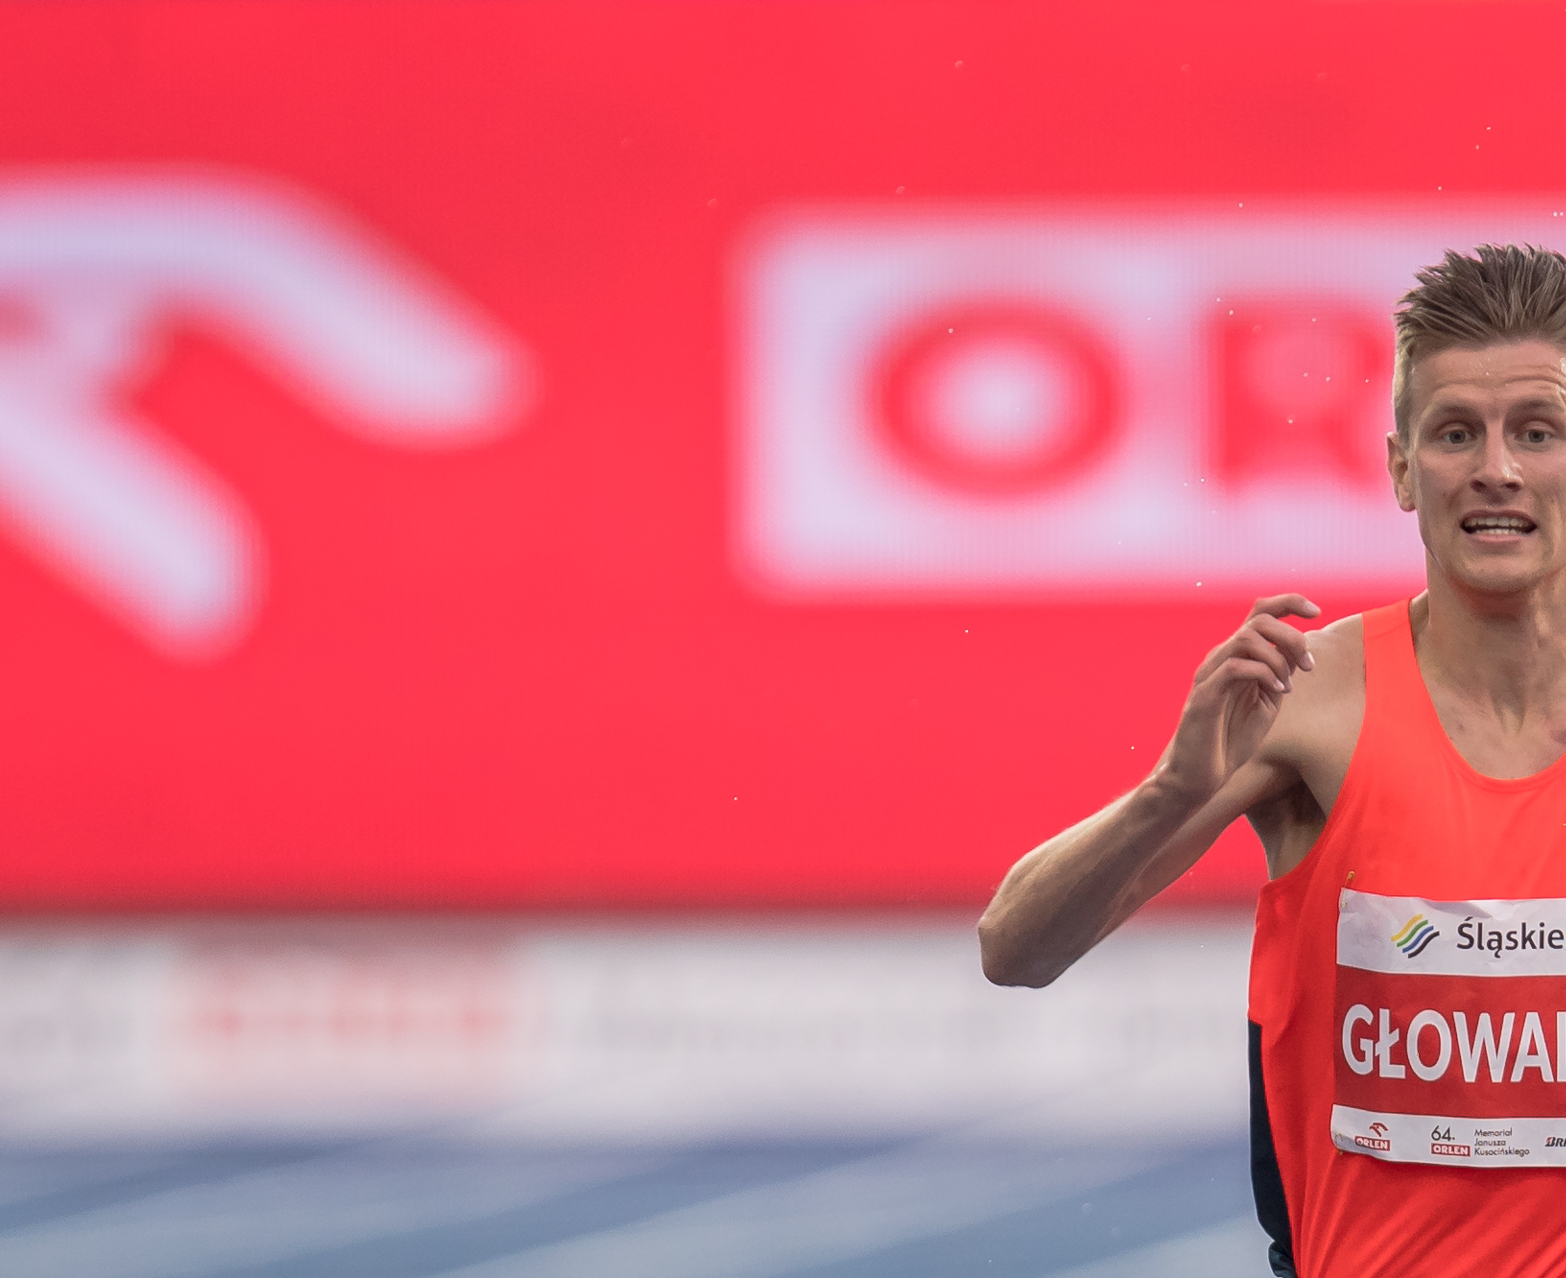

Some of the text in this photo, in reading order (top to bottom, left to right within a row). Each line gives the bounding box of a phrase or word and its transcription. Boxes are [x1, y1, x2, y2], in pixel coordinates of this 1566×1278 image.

[1430, 1125, 1456, 1141] 64.
[1355, 1137, 1389, 1150] ORLEN
[1432, 1144, 1469, 1156] ORLEN
